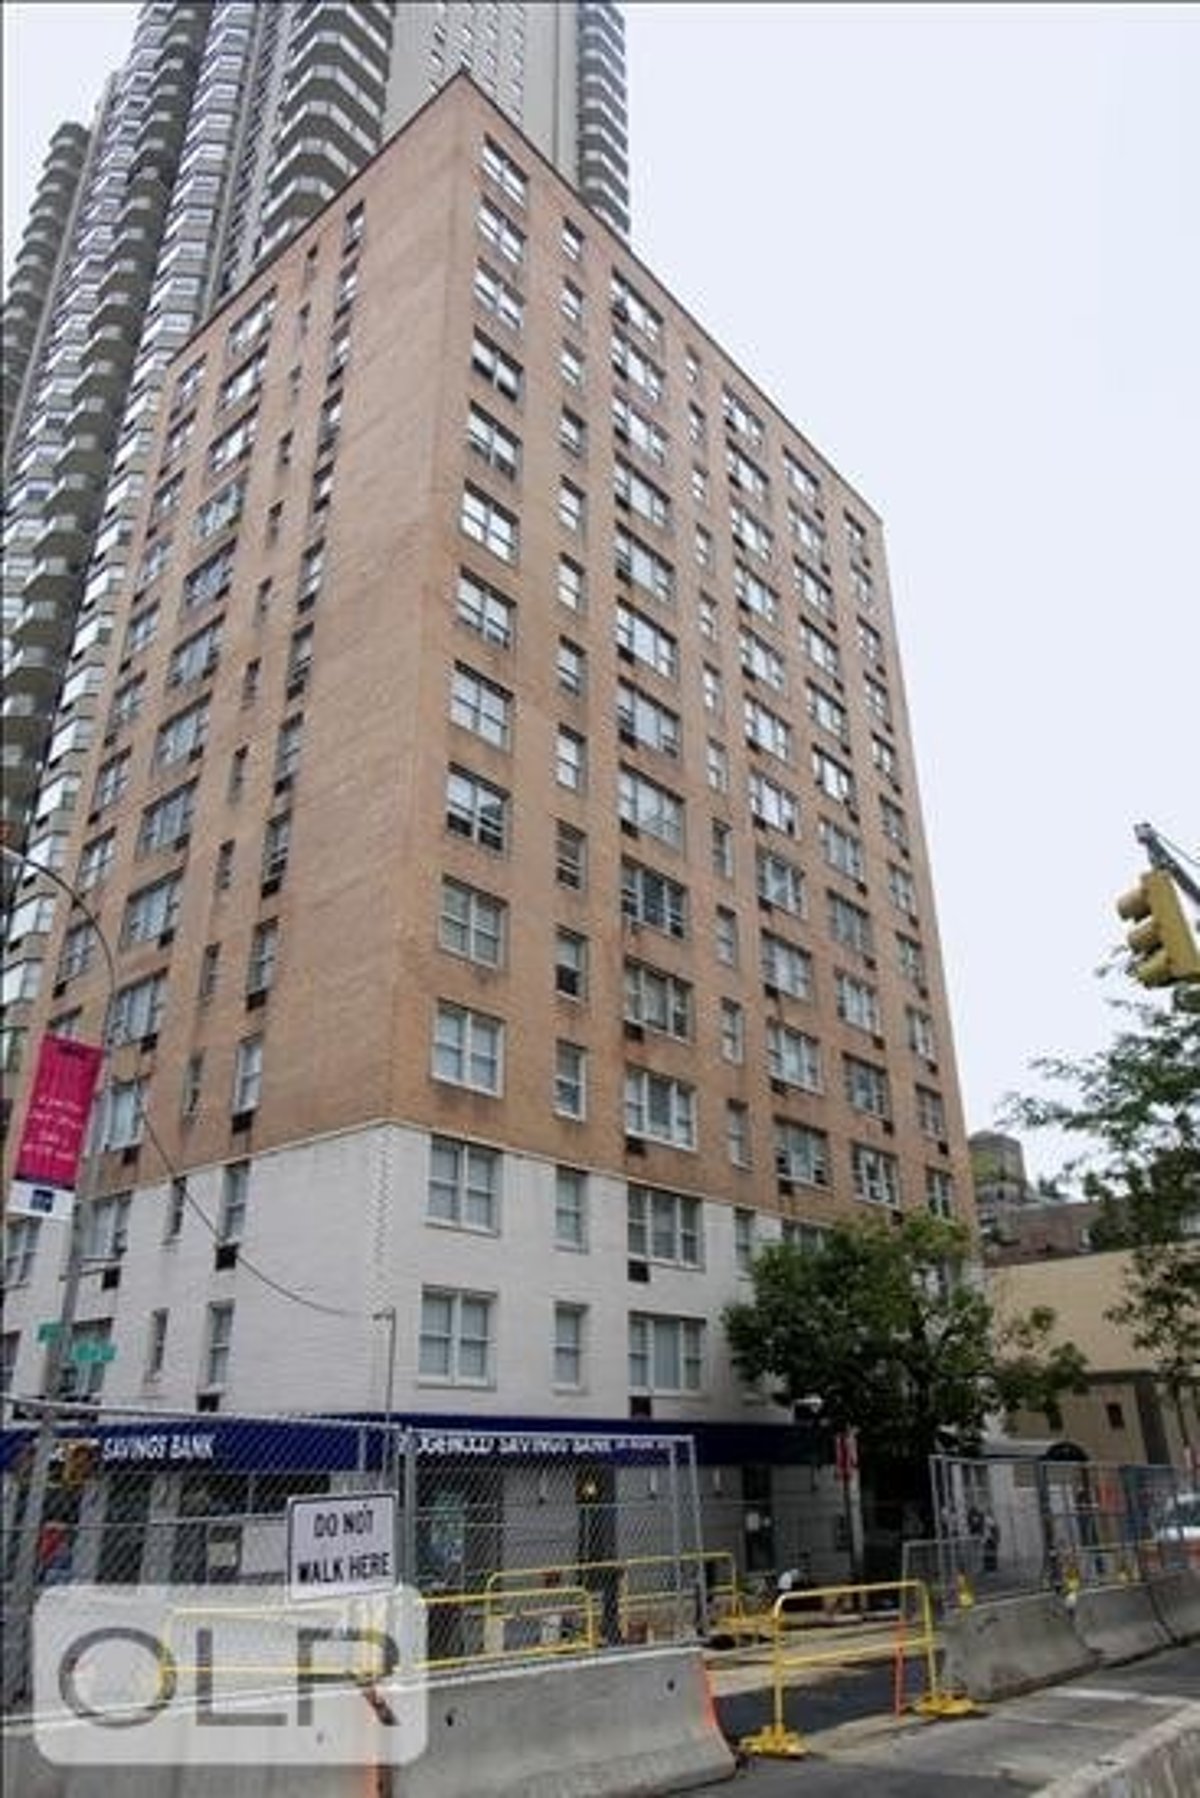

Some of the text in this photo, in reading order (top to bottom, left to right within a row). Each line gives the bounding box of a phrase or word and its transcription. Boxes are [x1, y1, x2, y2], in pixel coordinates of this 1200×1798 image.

[170, 1434, 216, 1459] BANK
[314, 1510, 374, 1538] DO NOT
[298, 1552, 390, 1584] WALK HERE
